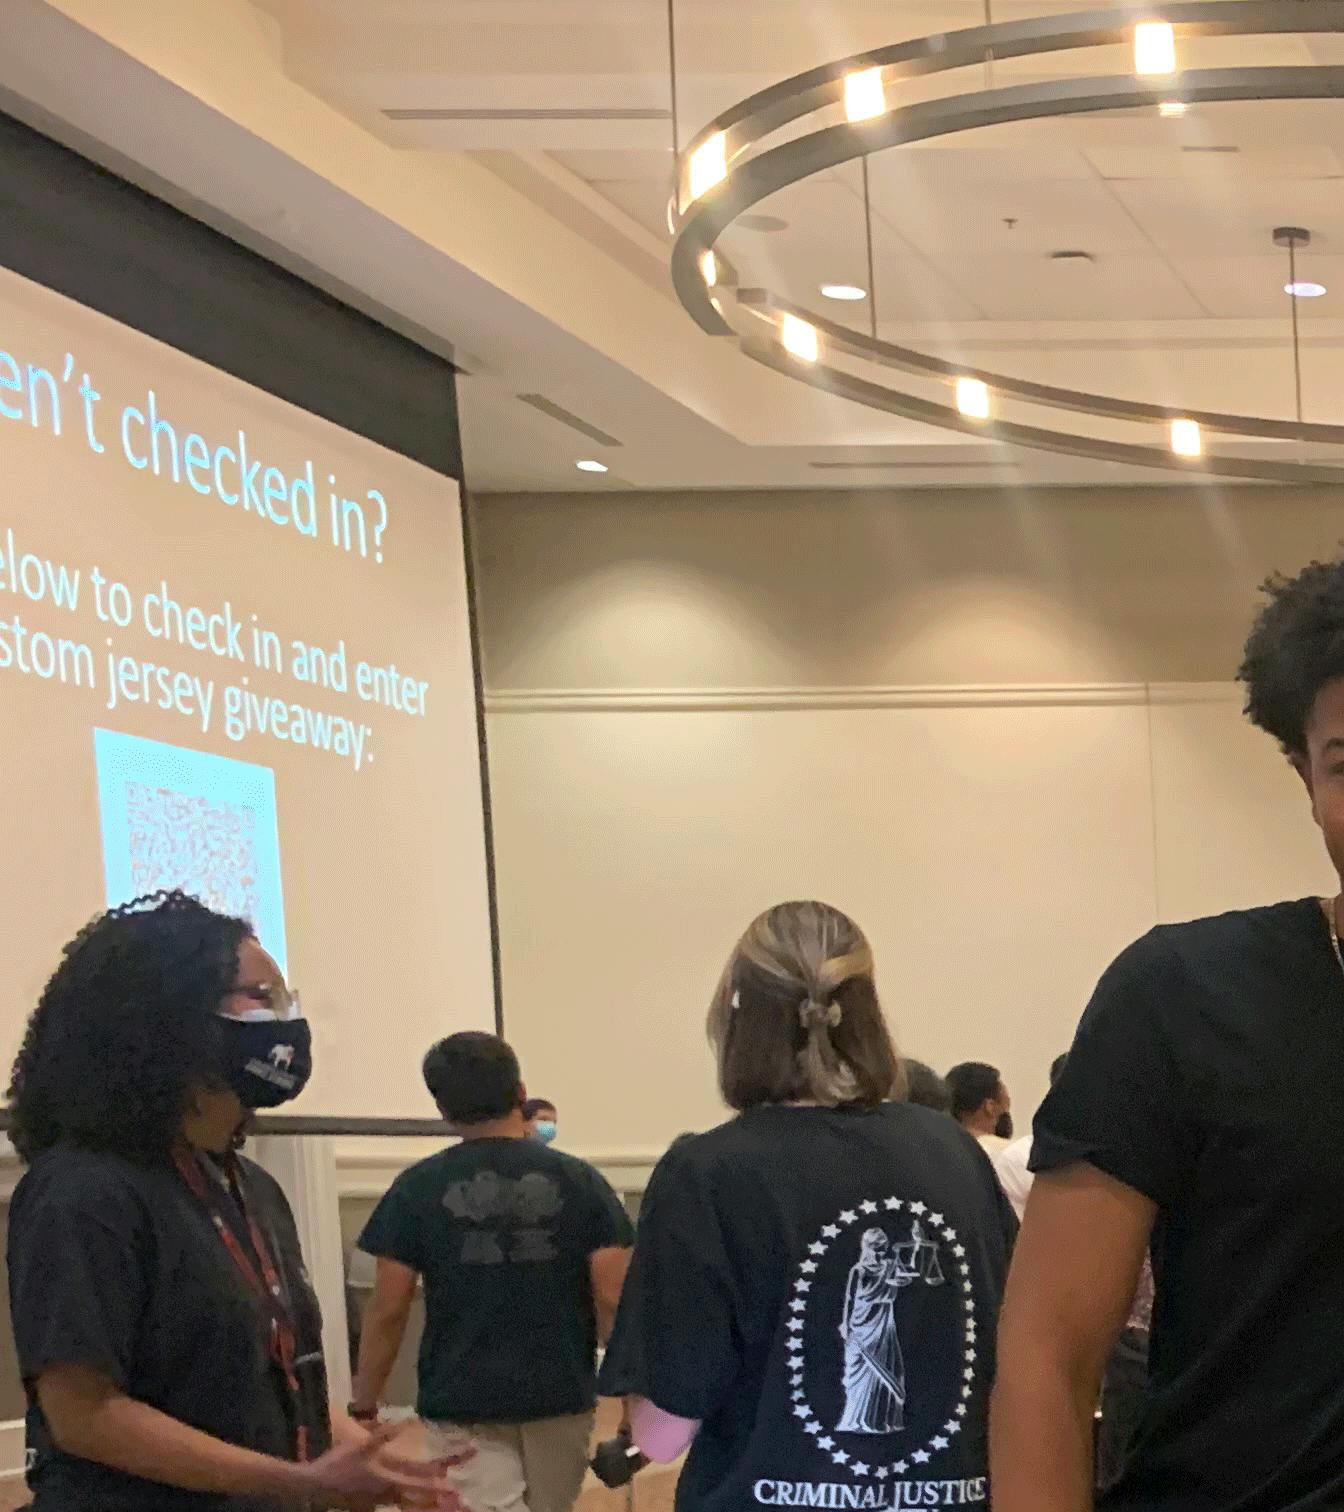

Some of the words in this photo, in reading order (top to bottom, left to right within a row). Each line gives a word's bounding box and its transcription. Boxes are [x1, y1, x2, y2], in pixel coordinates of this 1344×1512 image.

[121, 391, 318, 537] checked
[328, 474, 388, 563] in?
[91, 566, 131, 627] to
[144, 581, 244, 662] check
[251, 614, 283, 674] in
[292, 640, 348, 695] and
[356, 660, 429, 717] enter
[106, 637, 213, 732] jersey
[224, 677, 374, 771] giveaway:
[753, 1478, 887, 1509] CRIMINAL
